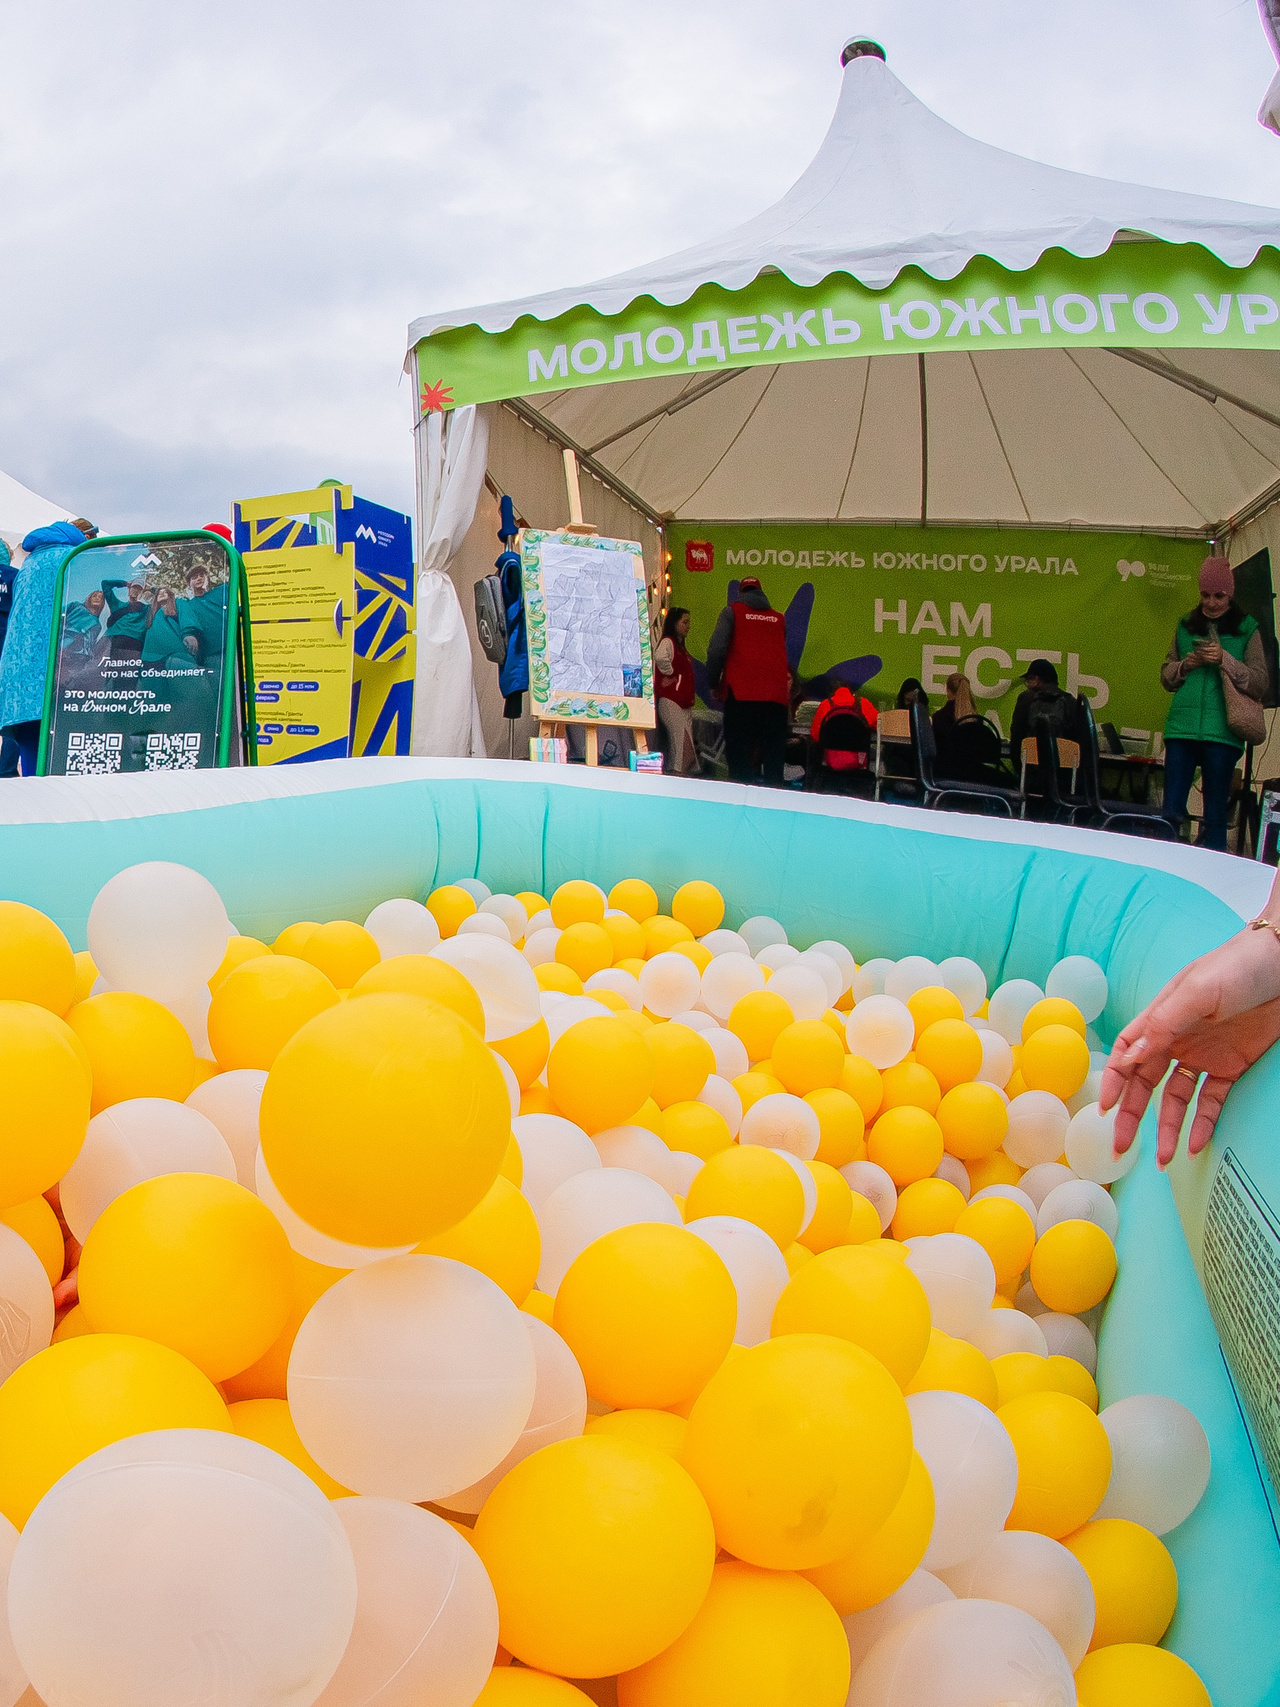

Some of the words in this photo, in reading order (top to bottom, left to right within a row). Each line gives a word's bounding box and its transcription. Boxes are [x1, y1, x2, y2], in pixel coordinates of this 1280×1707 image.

[527, 307, 861, 383] МОЛОДЕЖЬ
[879, 291, 1180, 341] ЮЖНОГО
[725, 549, 866, 569] МОЛОДЕЖЬ
[872, 551, 987, 573] ЮЖНОГО
[993, 554, 1080, 576] УРАЛА
[873, 598, 993, 638] НАМ
[97, 656, 144, 668] Главное,
[100, 669, 118, 678] что
[120, 669, 139, 678] нас
[141, 667, 206, 679] объединяет
[64, 690, 85, 699] это
[87, 690, 156, 700] молодость
[63, 703, 79, 712] на
[80, 699, 127, 713] Южном
[128, 699, 172, 716] Урале
